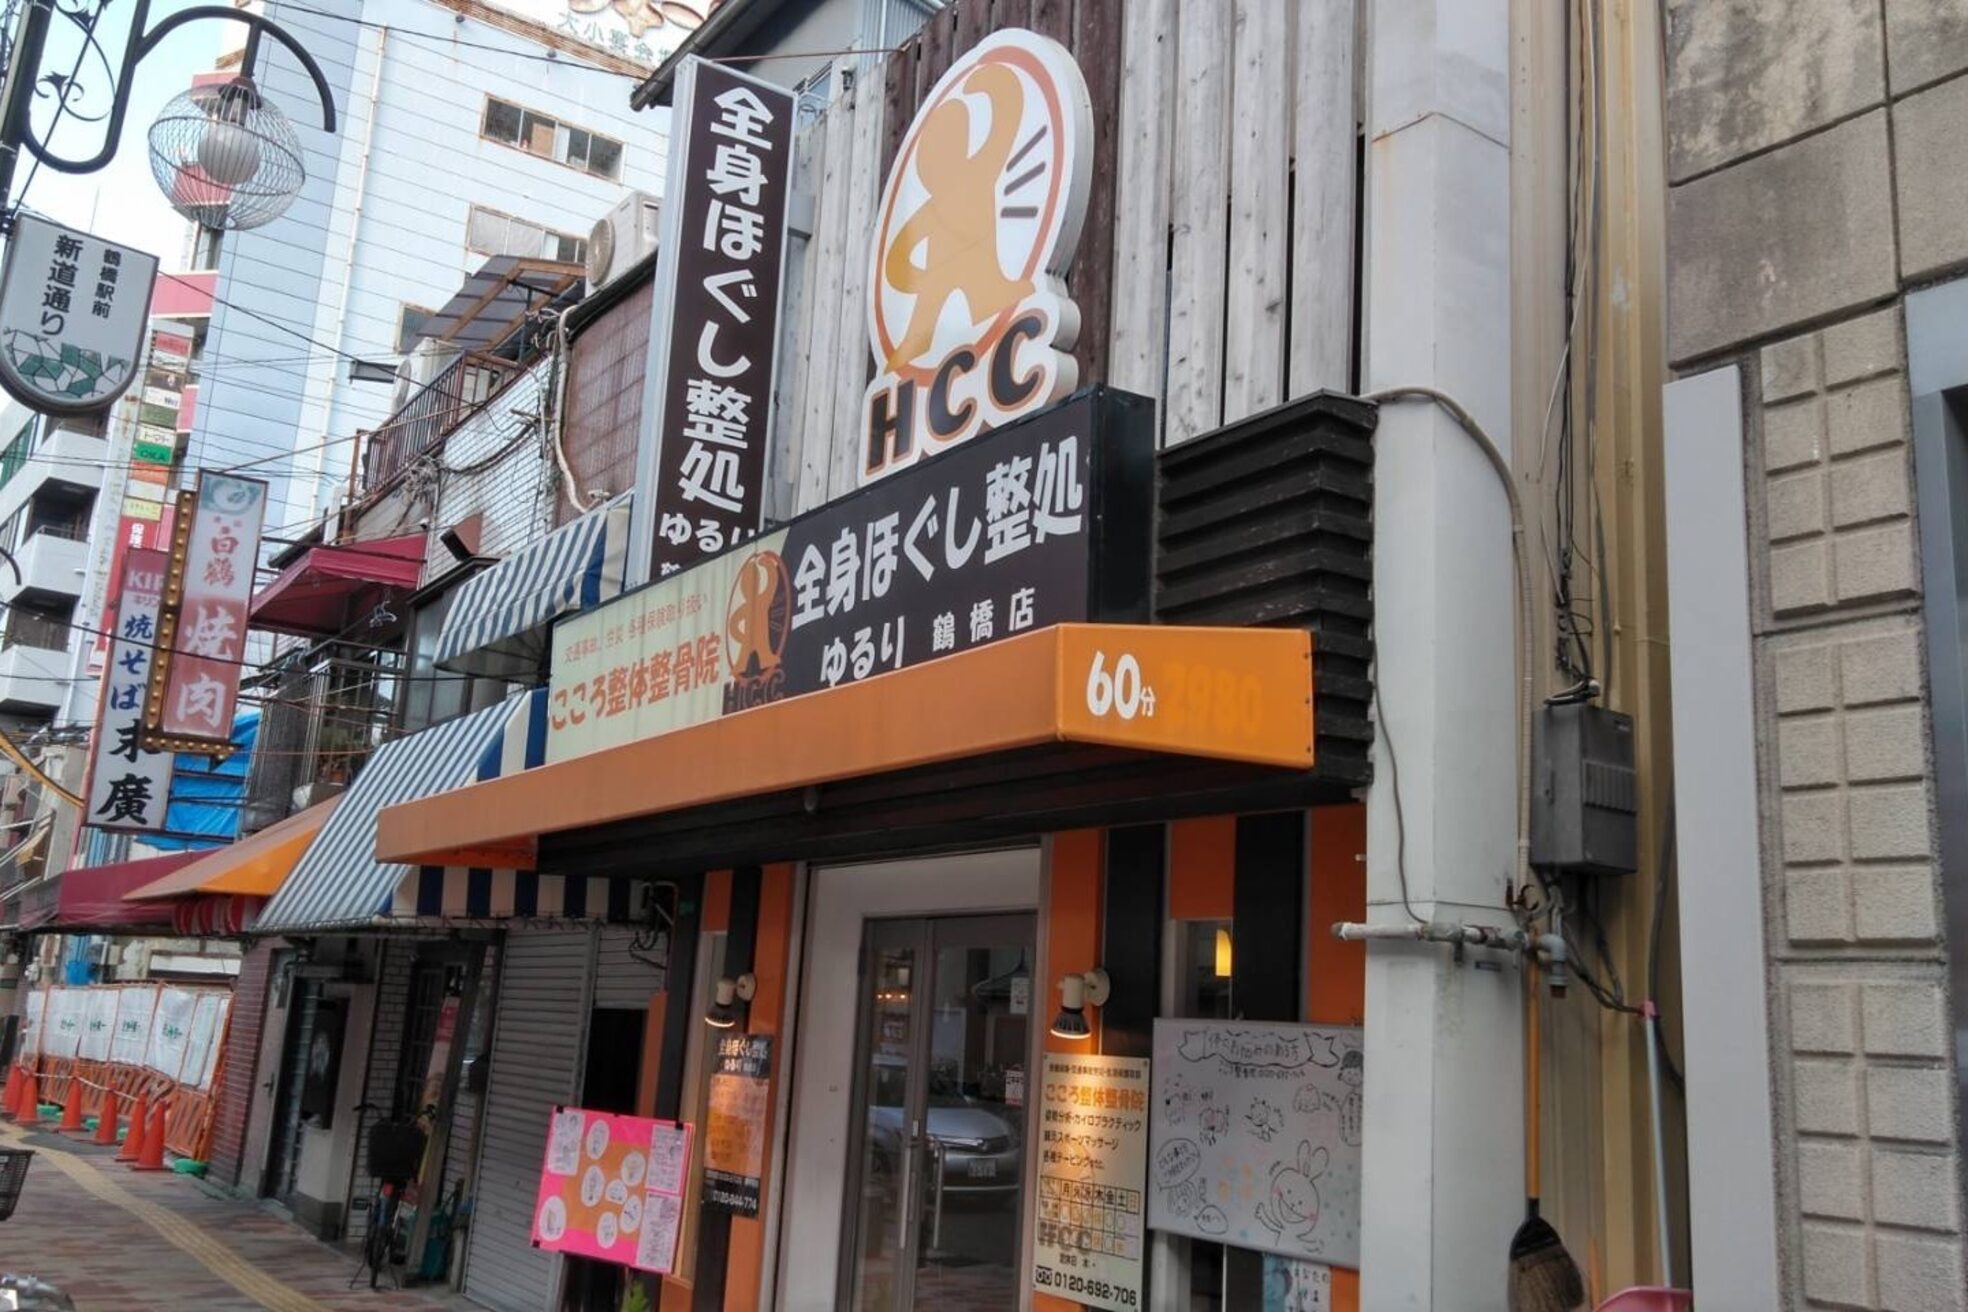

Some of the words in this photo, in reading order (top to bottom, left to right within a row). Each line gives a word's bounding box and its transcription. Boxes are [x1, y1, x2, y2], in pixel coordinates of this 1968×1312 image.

[40, 234, 84, 336] 新道通り
[678, 87, 774, 513] 全身ほぐし整処
[865, 307, 1049, 476] HCC
[792, 436, 1083, 631] 全身ほぐし整処
[176, 604, 239, 727] 焼肉
[551, 631, 721, 731] こころ整体整骨院
[820, 616, 905, 687] ゆるり
[932, 587, 1035, 652] 鶴橋店
[1086, 650, 1156, 720] 60分
